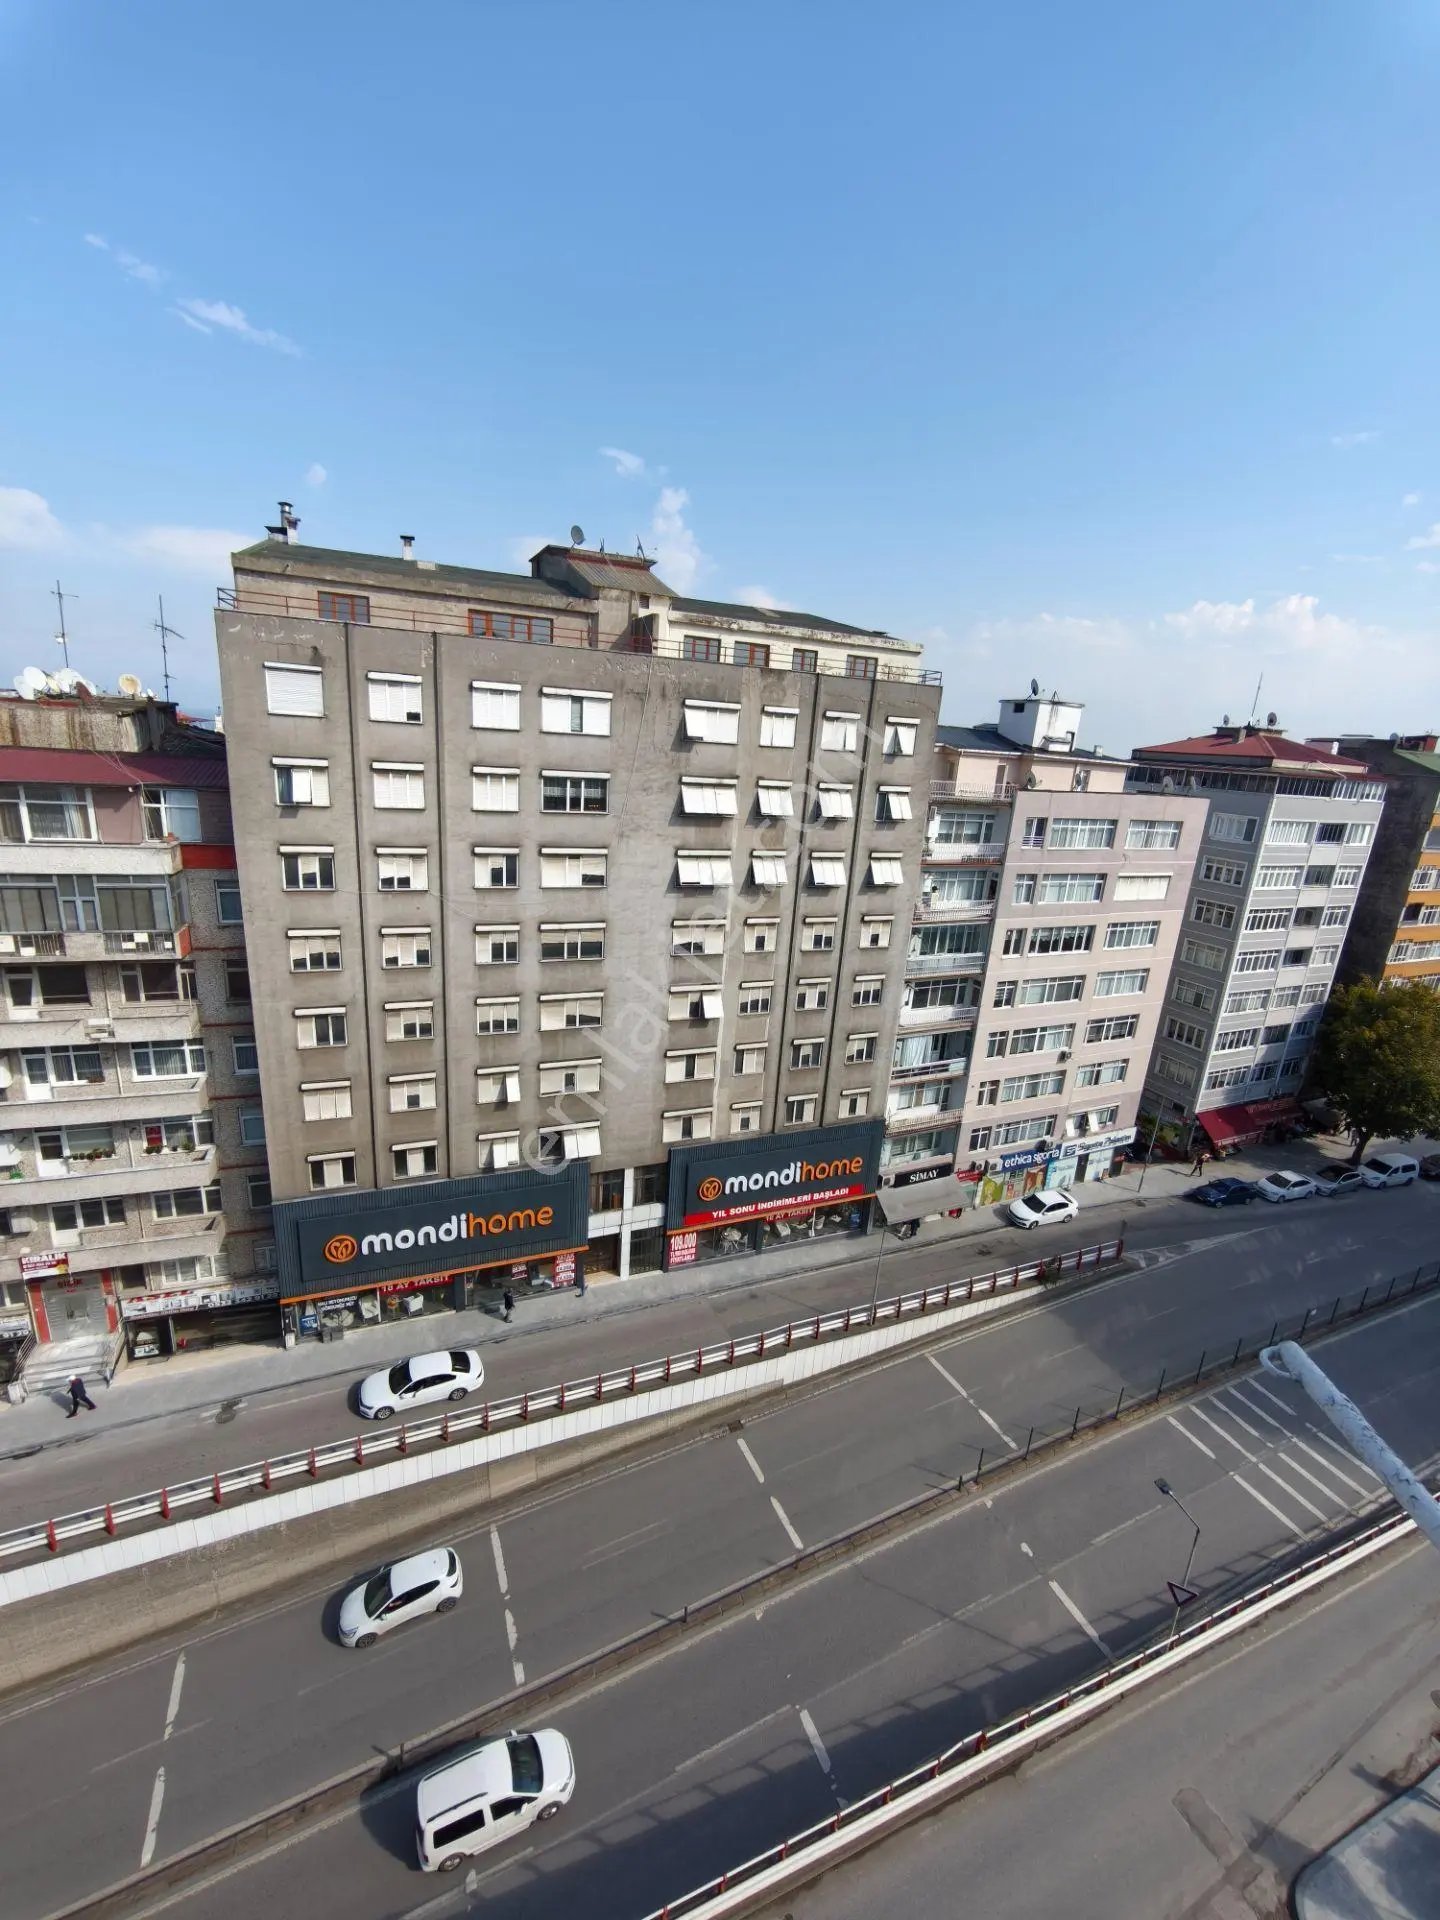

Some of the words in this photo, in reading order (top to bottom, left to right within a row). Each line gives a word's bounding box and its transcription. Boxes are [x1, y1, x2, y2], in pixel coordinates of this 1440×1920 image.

[1004, 1154, 1032, 1168] ethica
[1033, 1148, 1060, 1165] sigorta
[725, 1156, 863, 1195] mondihome
[909, 1167, 938, 1183] SİMAY
[712, 1209, 727, 1219] YIL
[729, 1205, 756, 1216] SONU
[758, 1192, 812, 1211] İNDİRİMLERİ
[813, 1187, 849, 1201] BAŞLADI
[361, 1205, 553, 1256] mondihome
